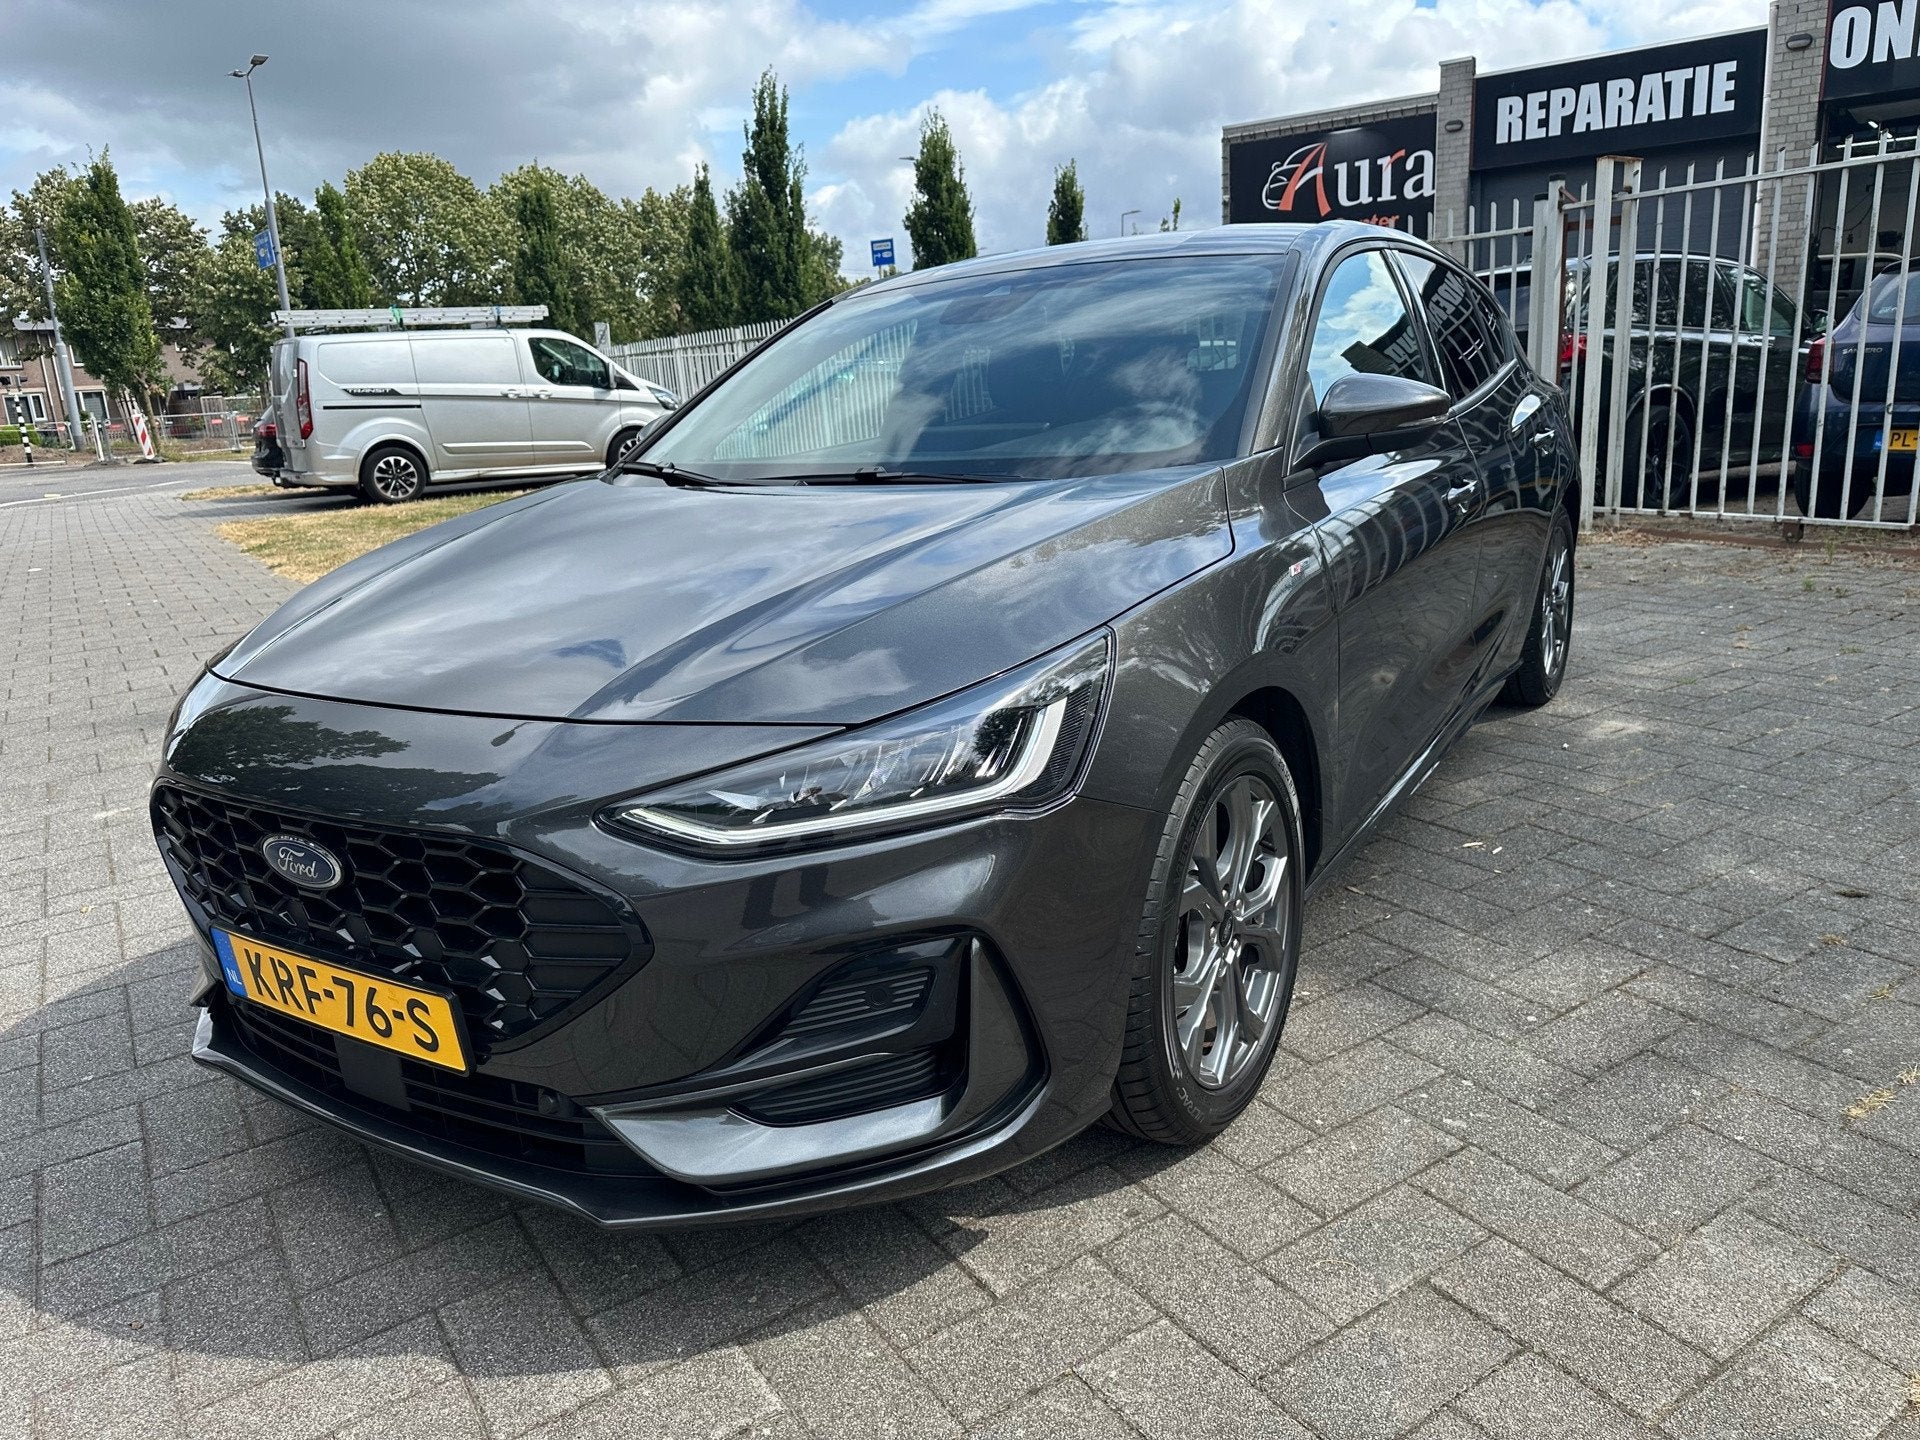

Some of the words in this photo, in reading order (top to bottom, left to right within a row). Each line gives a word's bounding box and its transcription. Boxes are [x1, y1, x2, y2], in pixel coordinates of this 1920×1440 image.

[1830, 0, 1920, 69] ON
[1496, 60, 1737, 144] REPARATIE
[1278, 142, 1435, 217] Aura
[1842, 347, 1883, 355] SANERO
[277, 846, 319, 879] Ford
[225, 967, 243, 986] NL
[244, 948, 439, 1052] KRF-76-S
